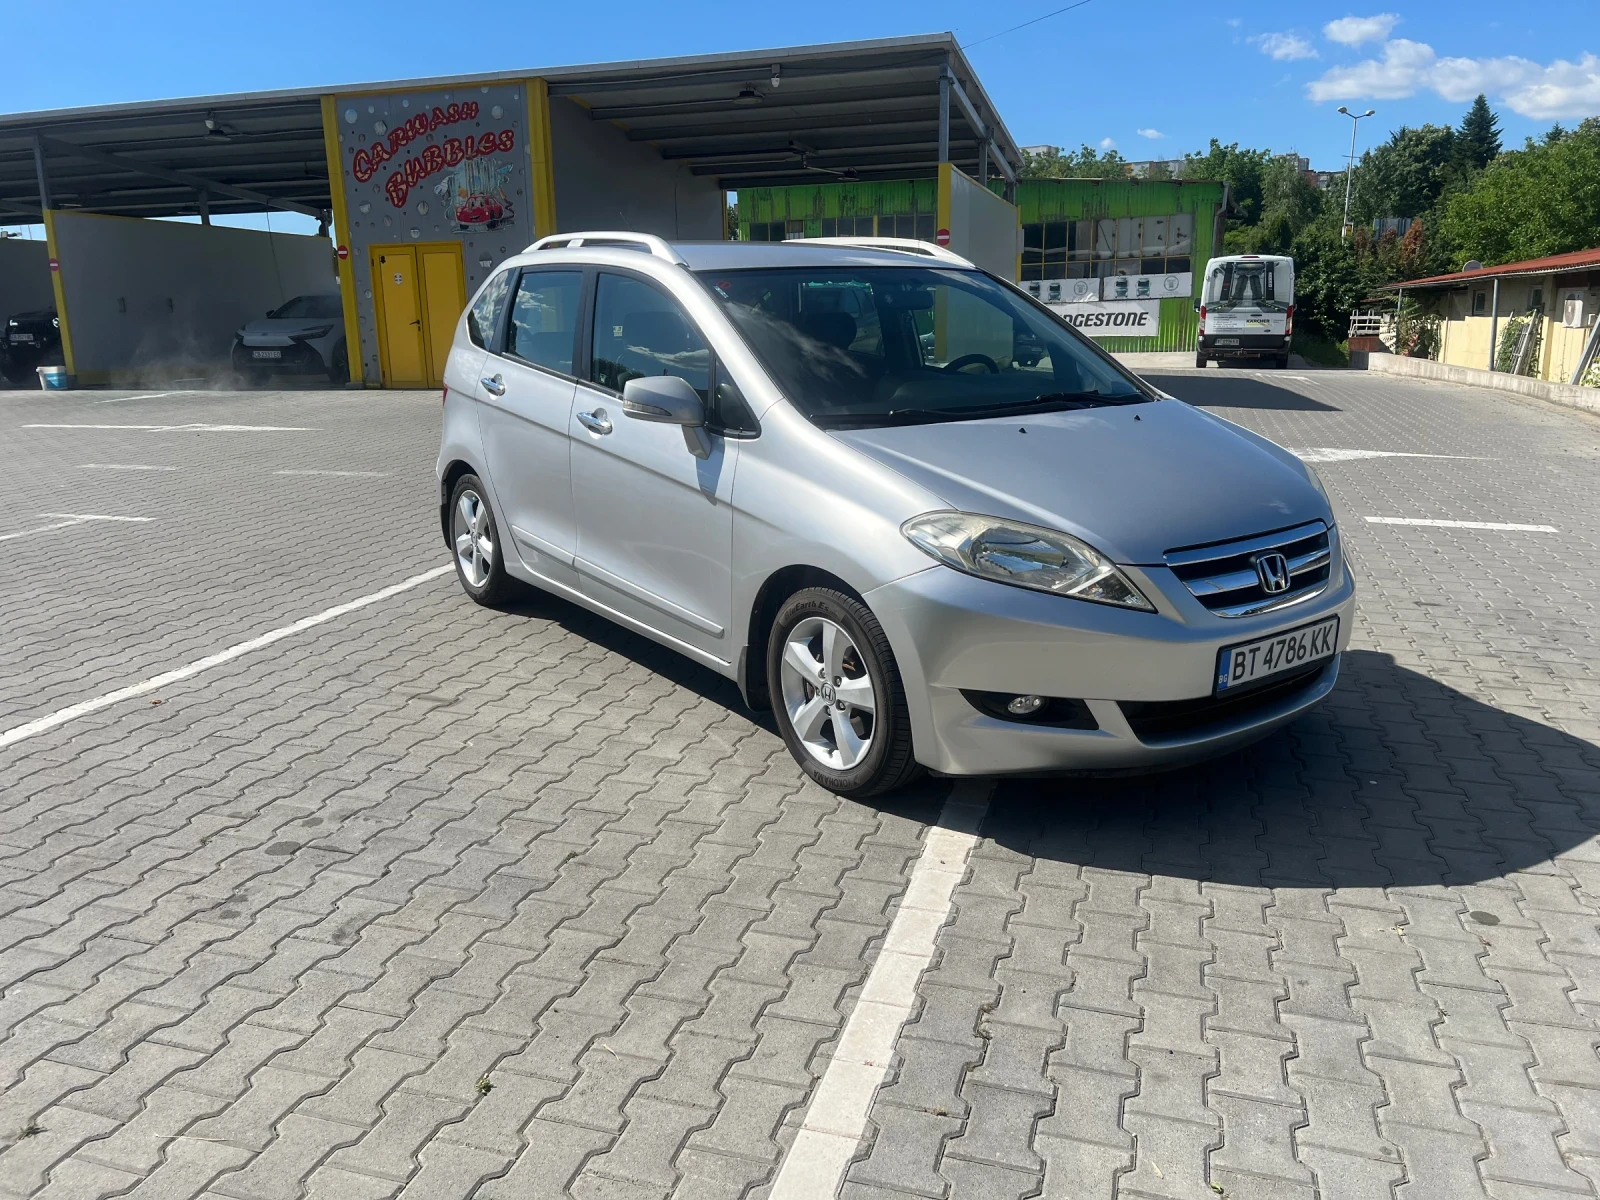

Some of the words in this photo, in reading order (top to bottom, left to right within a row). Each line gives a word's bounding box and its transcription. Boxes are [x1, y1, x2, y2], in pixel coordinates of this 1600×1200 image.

[353, 101, 479, 183] CARWASH
[386, 129, 514, 208] BUBBLES
[1061, 312, 1149, 327] DGESTONE
[1218, 674, 1228, 684] BG
[1232, 647, 1261, 681] BT
[1263, 633, 1307, 671] 4786
[1309, 624, 1333, 657] KK
